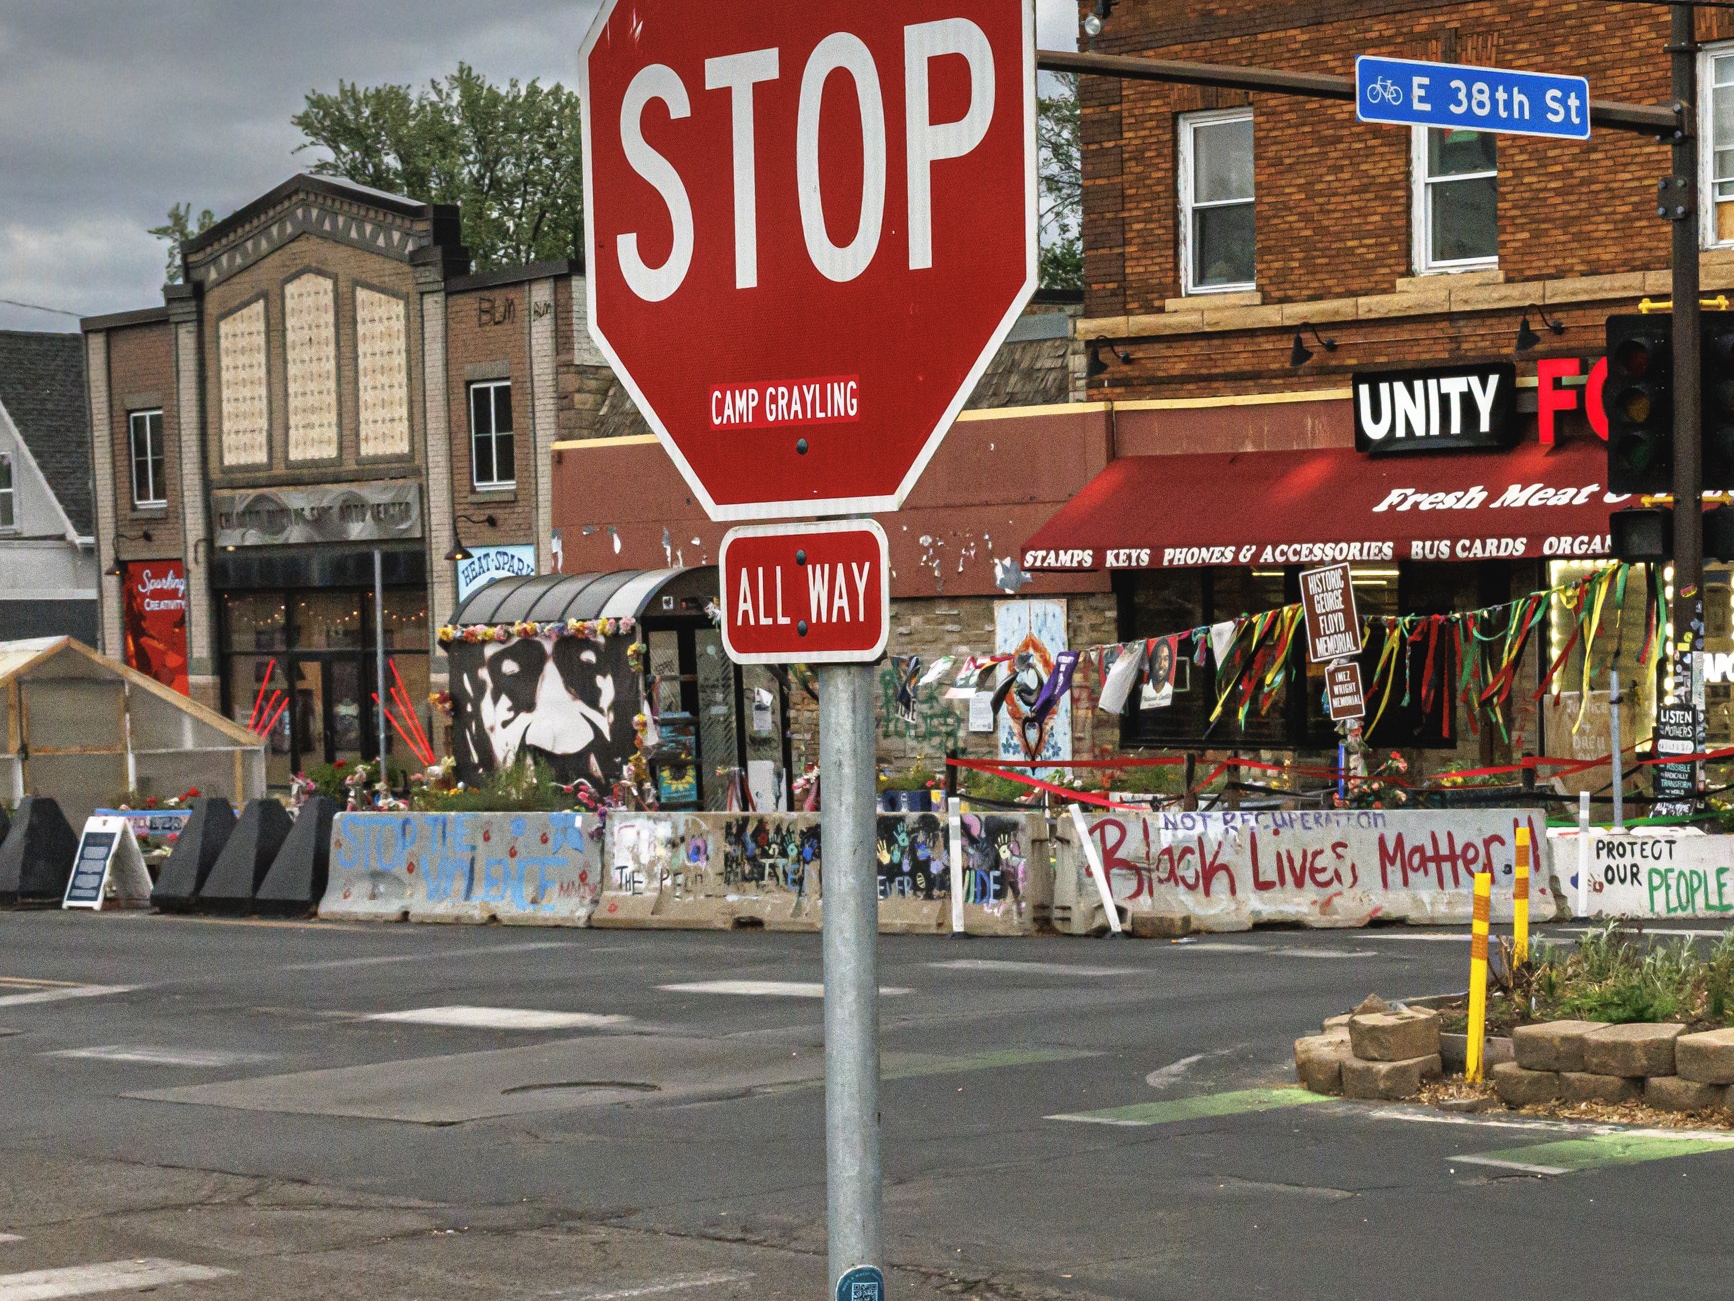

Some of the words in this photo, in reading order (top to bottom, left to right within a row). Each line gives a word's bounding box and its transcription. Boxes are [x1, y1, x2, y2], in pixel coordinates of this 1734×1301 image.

[1411, 75, 1432, 112] E
[1449, 79, 1530, 121] 38th
[1545, 88, 1581, 125] St
[616, 15, 996, 304] STOP
[711, 388, 760, 426] CAMP
[765, 380, 859, 422] GRAYLING
[1358, 373, 1500, 441] UNITY
[1372, 486, 1490, 512] Fresh
[1490, 483, 1601, 508] Meat
[1024, 549, 1093, 568] STAMPS
[1105, 548, 1150, 567] KEYS
[1162, 546, 1235, 566] PHONES
[1238, 544, 1257, 563] &
[1259, 540, 1394, 563] ACCESSORIES
[1411, 539, 1451, 560] BUS
[1455, 537, 1528, 558] CARDS
[737, 565, 791, 626] ALL
[807, 561, 871, 624] WAY
[1307, 568, 1344, 596] HISTORIC
[1313, 588, 1345, 615] GEORGE
[1319, 611, 1346, 636] FLOYD
[1315, 631, 1357, 658] MEMORIAL
[1332, 694, 1362, 708] MEMORIAL
[1333, 682, 1356, 696] WRIGHT
[1660, 710, 1692, 724] LISTEN
[1664, 724, 1693, 738] MOTHERS
[1660, 778, 1692, 789] TRANSFORM
[424, 813, 478, 853] THE
[1163, 813, 1212, 831] NOT
[338, 814, 418, 871] STOP
[1596, 839, 1677, 860] PROTECT
[1086, 817, 1237, 901] Black
[420, 854, 568, 911] VIOLENCE
[615, 865, 643, 896] THE
[1604, 863, 1642, 887] OUR
[1647, 866, 1734, 914] PEOPLE
